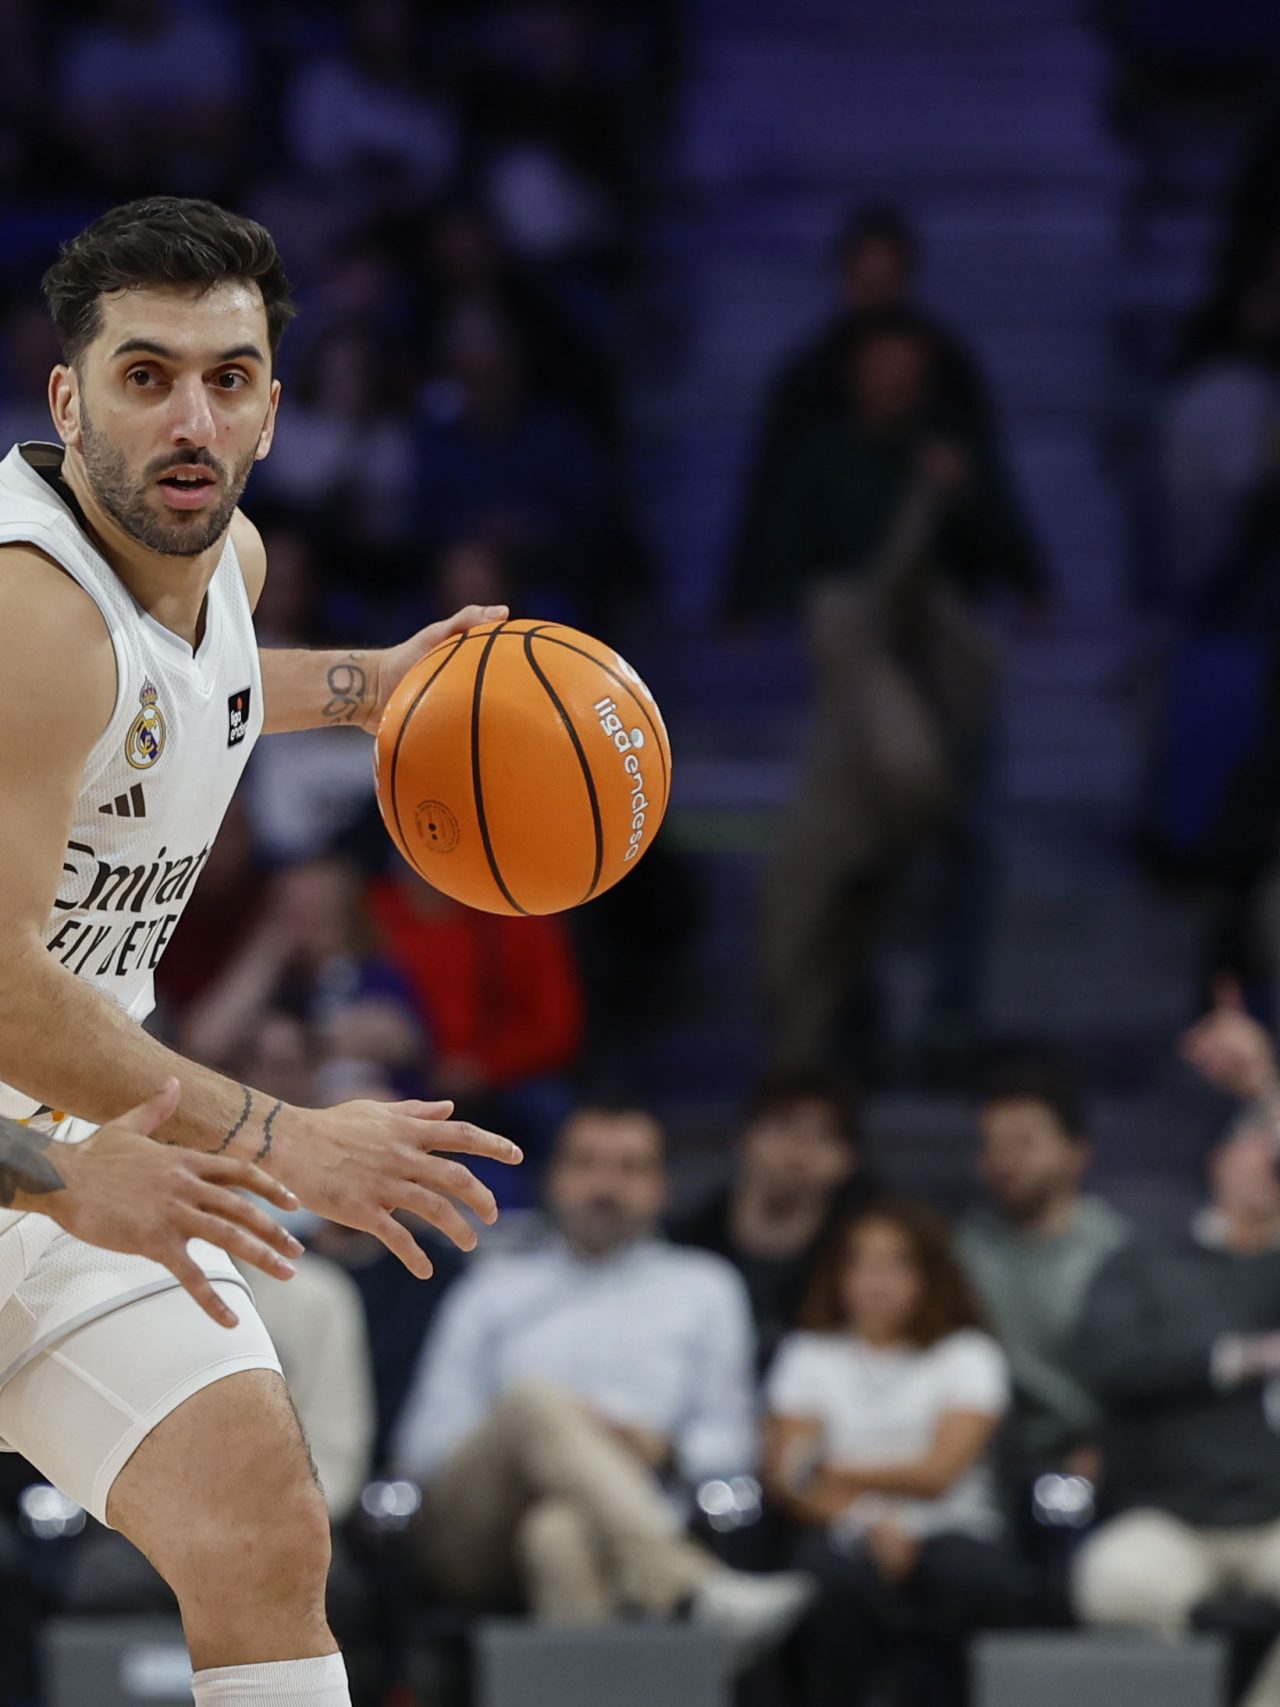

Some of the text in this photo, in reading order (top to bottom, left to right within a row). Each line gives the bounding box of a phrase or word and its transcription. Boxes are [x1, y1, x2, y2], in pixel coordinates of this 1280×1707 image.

[593, 697, 649, 862] liga endesa
[54, 840, 211, 913] Emirat
